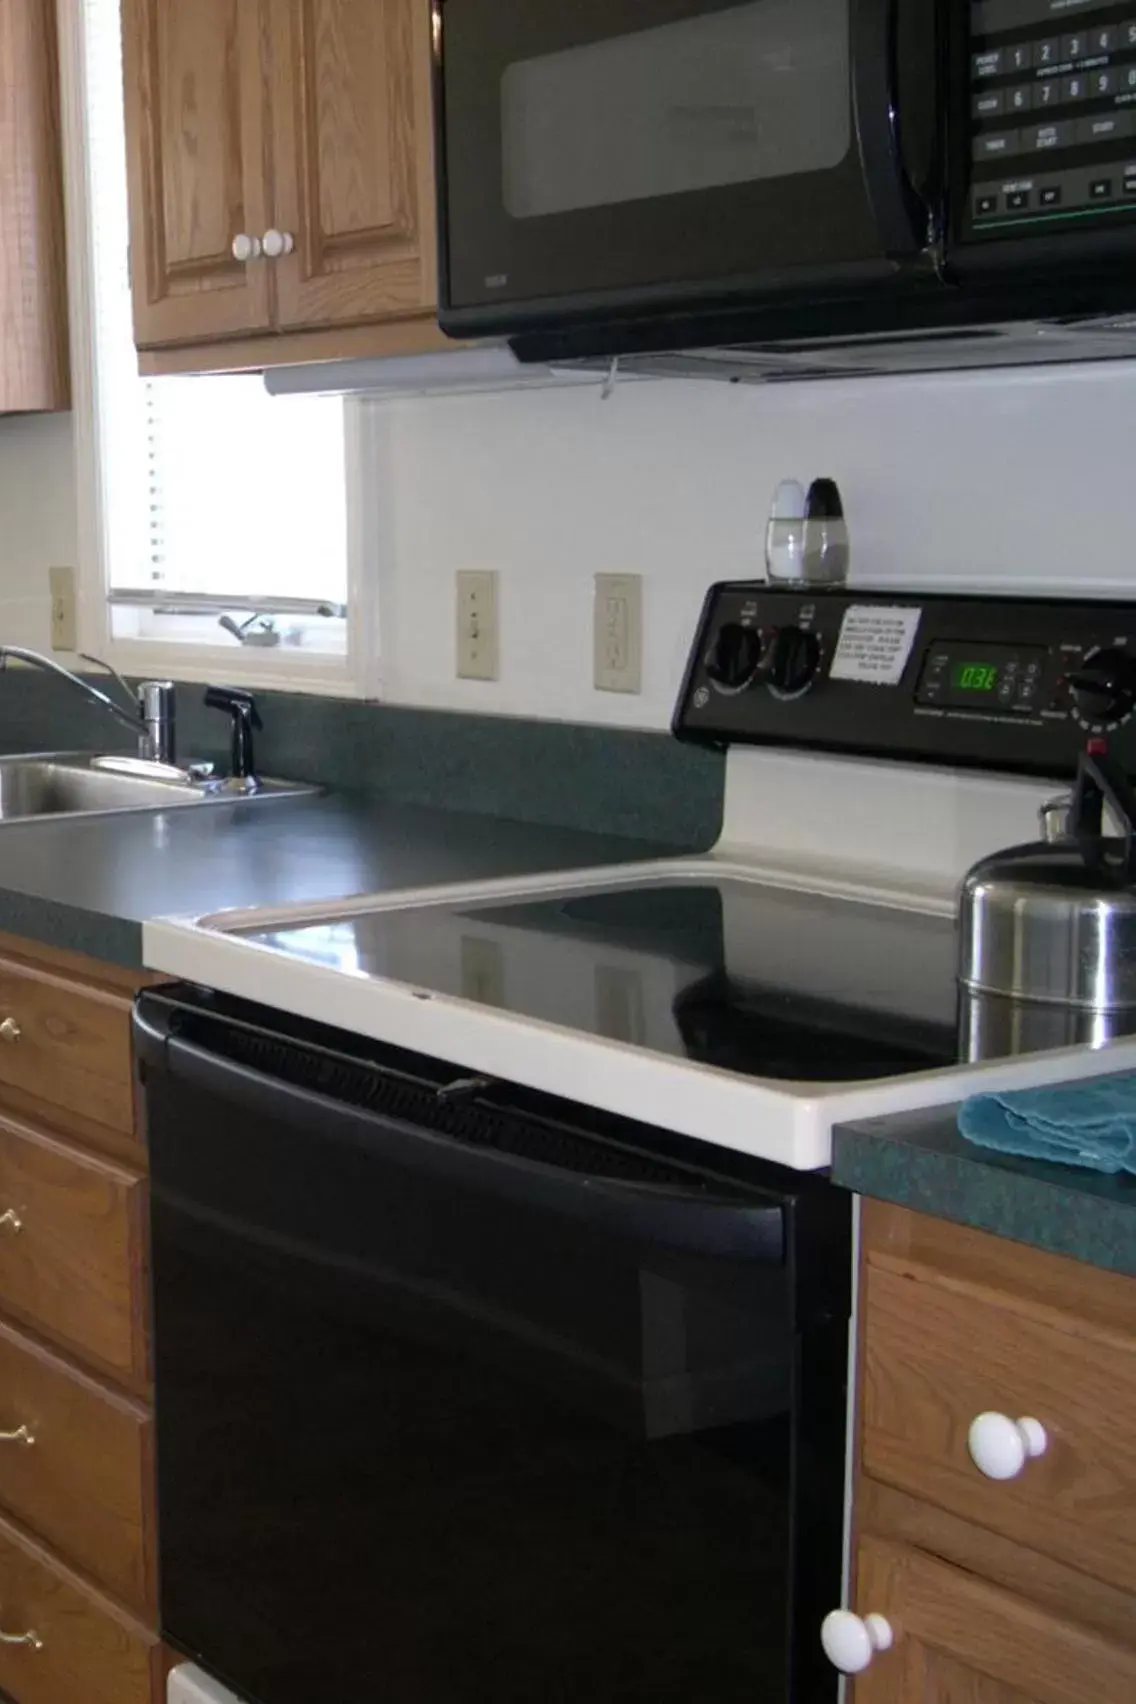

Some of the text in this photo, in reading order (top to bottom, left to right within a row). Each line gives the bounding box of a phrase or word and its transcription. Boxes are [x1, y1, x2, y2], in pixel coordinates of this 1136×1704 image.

[1041, 45, 1051, 61] 2
[1070, 38, 1080, 55] 3
[1098, 32, 1108, 48] 4
[1013, 91, 1023, 108] 6
[1070, 80, 1079, 96] 8
[1098, 74, 1108, 91] 9
